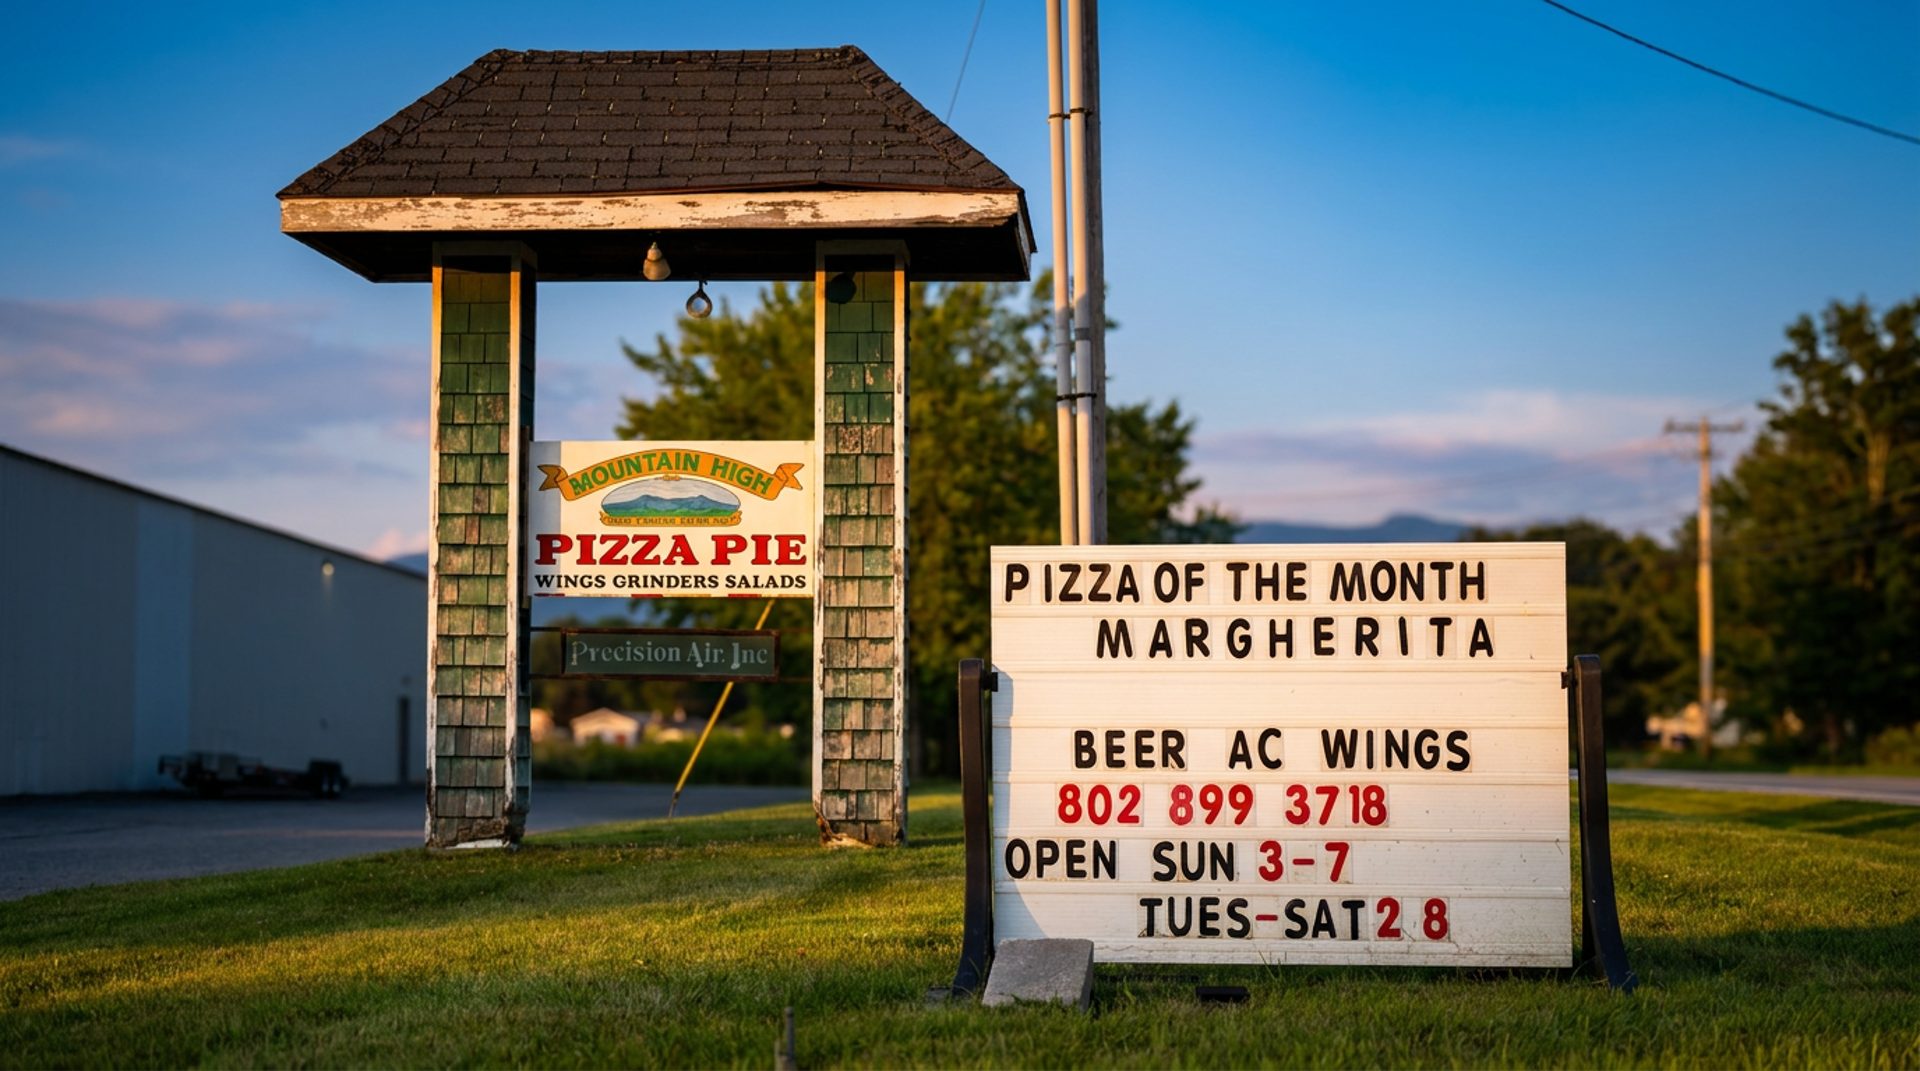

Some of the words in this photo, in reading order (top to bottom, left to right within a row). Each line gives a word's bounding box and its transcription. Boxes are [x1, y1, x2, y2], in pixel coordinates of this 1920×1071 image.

[568, 451, 701, 497] MOUNTAIN
[711, 456, 775, 495] HIGH
[534, 533, 700, 566] PIZZA
[710, 533, 807, 566] PIE
[534, 574, 606, 589] WINGS
[612, 574, 720, 589] GRINDERS
[724, 574, 807, 589] SALADS
[1004, 561, 1141, 604] PIZZA
[1152, 560, 1206, 604] OF
[1225, 560, 1308, 603] THE
[1328, 559, 1486, 603] MONTH
[571, 640, 682, 666] Precision
[730, 641, 768, 669] Inc
[1095, 616, 1495, 660] MARGHERITA
[1073, 728, 1187, 770] BEER
[1227, 726, 1284, 771] AC
[1320, 727, 1472, 773] WINGS
[1057, 783, 1142, 826] 802
[1168, 783, 1255, 827] 899
[1284, 783, 1389, 828] 3718
[1003, 837, 1118, 881] OPEN
[1151, 839, 1236, 883] SUN
[1257, 839, 1351, 884] 3-7
